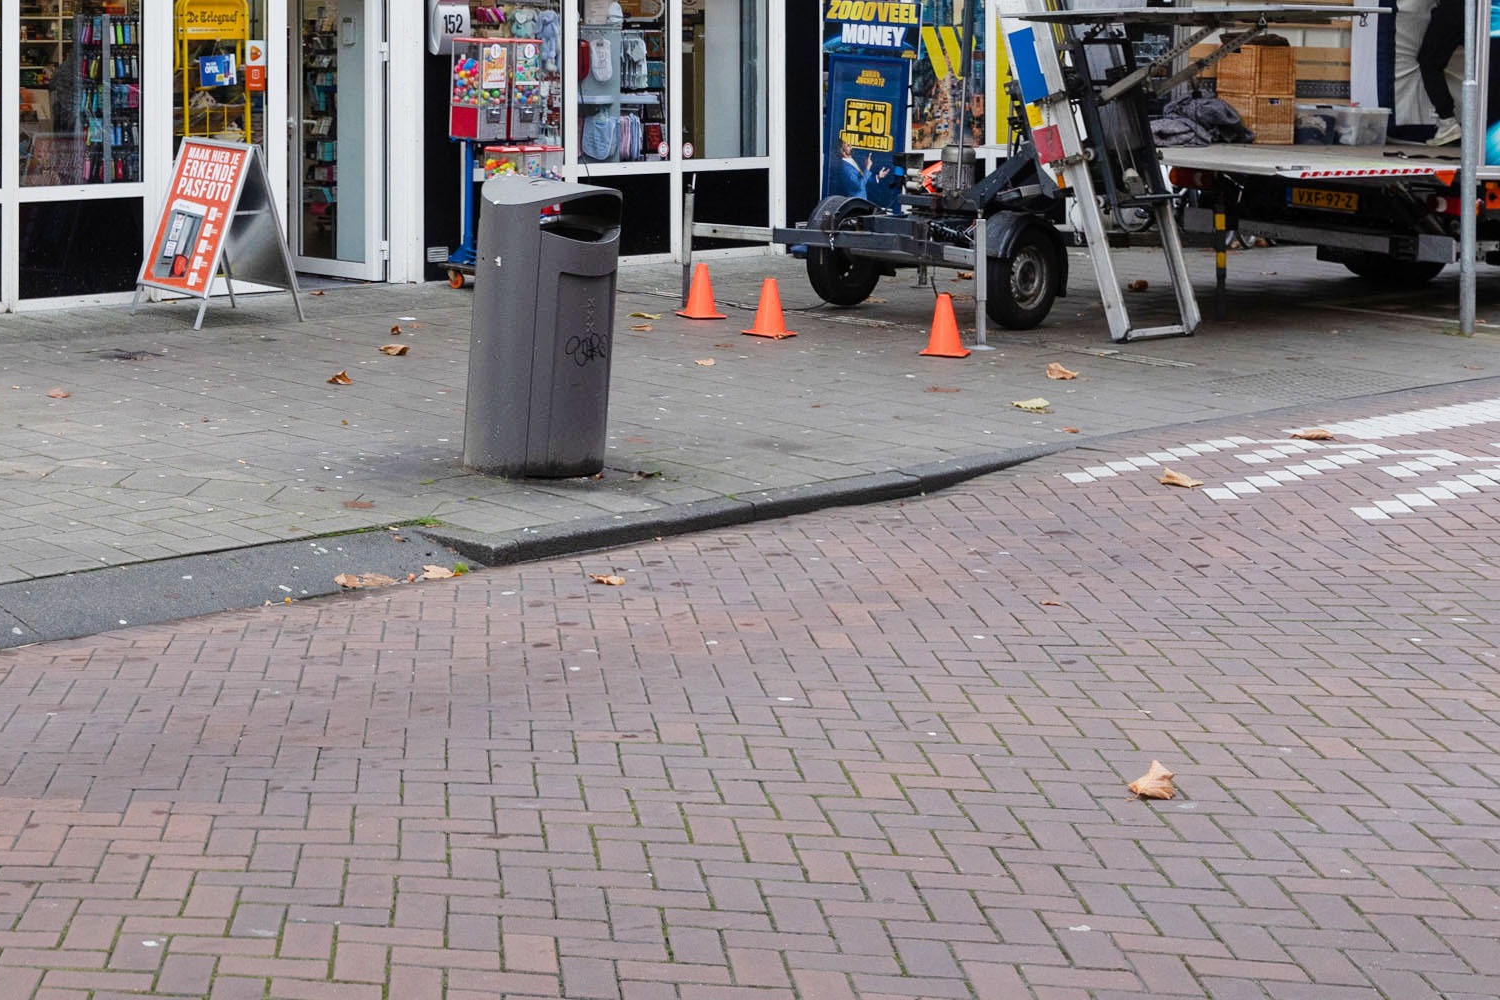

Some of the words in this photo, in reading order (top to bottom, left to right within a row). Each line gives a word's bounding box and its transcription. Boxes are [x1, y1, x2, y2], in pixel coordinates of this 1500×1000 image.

[187, 11, 199, 23] De
[200, 10, 238, 25] Telegraaf
[444, 14, 463, 34] 152
[841, 23, 906, 47] MONEY
[847, 110, 885, 134] 120
[841, 132, 888, 149] MILJOEN
[187, 147, 211, 161] MAAK
[211, 150, 231, 163] HIER
[230, 152, 241, 165] JE
[182, 158, 237, 183] ERKENDE
[176, 176, 231, 202] PASFOTO
